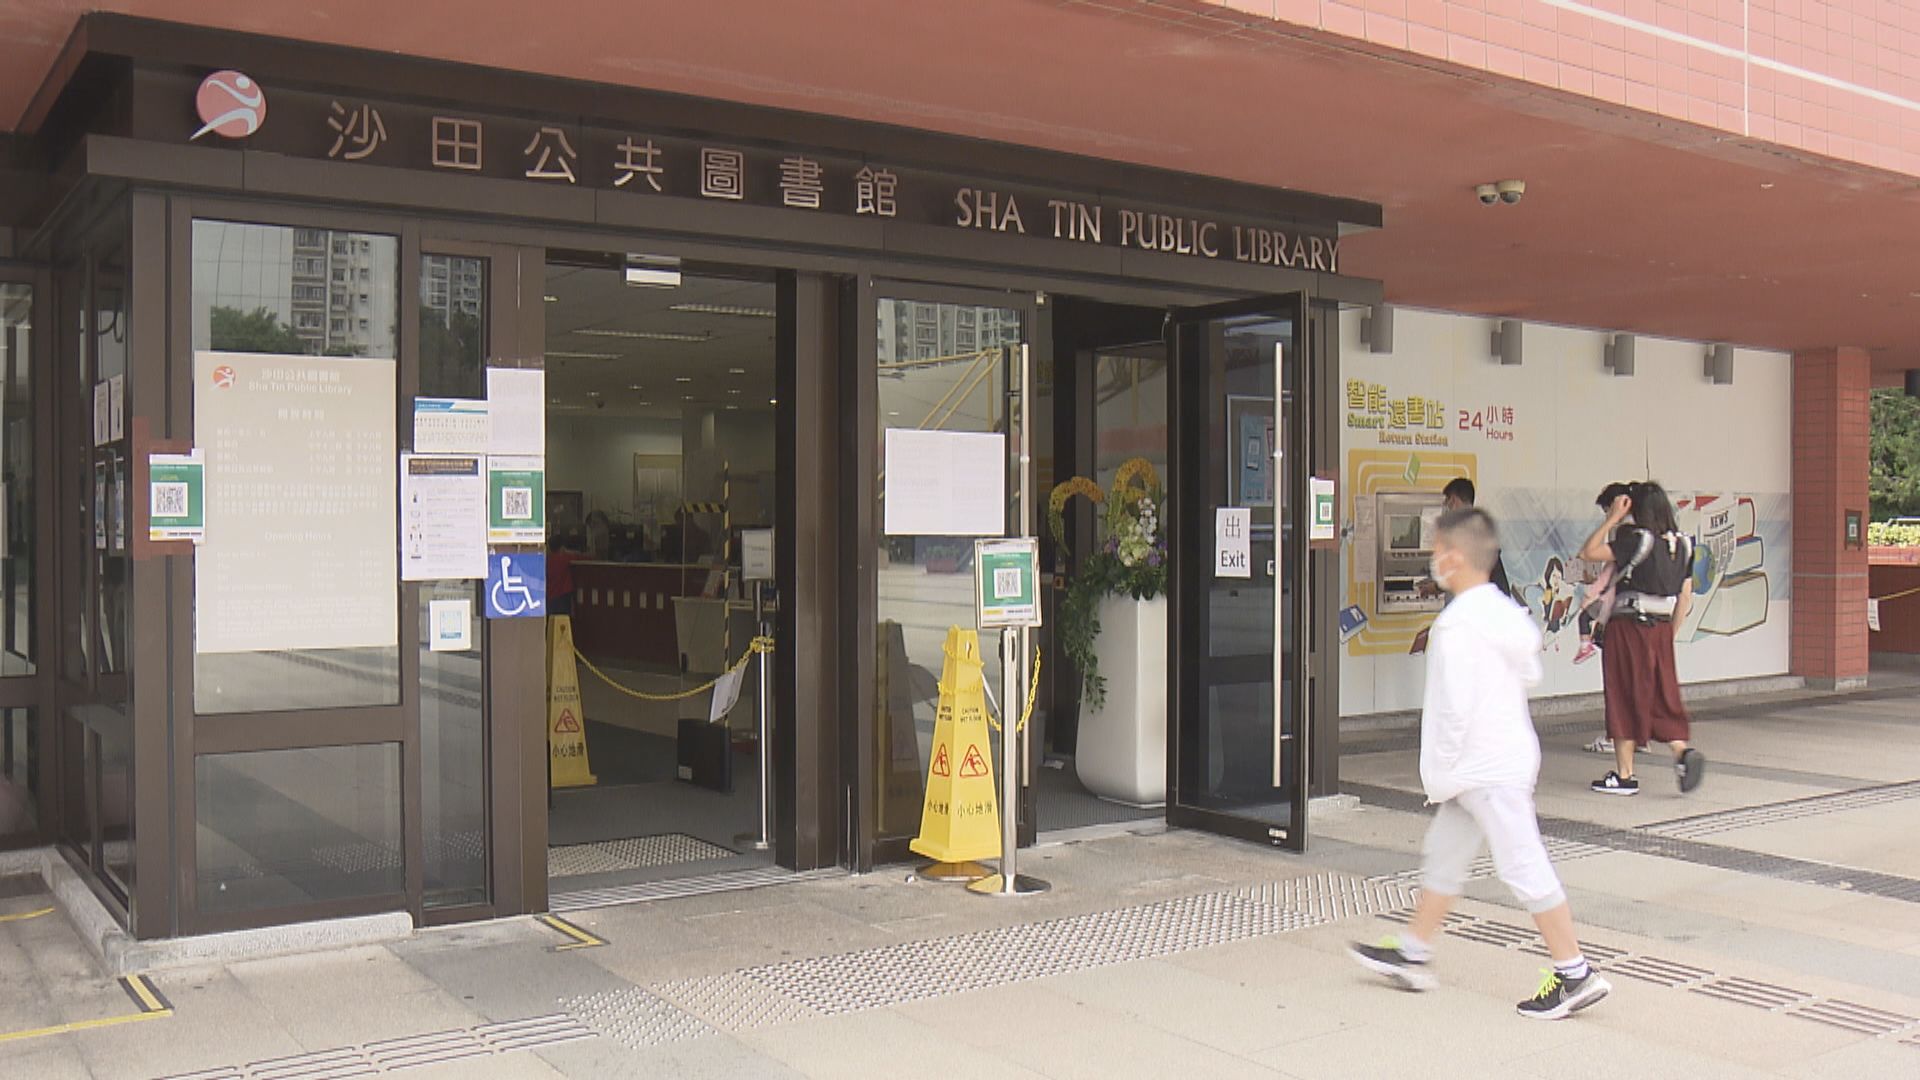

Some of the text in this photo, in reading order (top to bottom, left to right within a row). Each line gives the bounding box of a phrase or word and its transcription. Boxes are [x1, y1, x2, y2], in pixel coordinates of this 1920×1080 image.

[328, 99, 897, 217] 沙田公共圖書館
[955, 187, 1340, 273] SHA TIN PUBLIC LIBRARY
[270, 382, 286, 392] Tin
[287, 382, 317, 393] Public
[319, 382, 352, 395] Library
[1346, 378, 1445, 429] 智能還書站
[1347, 413, 1385, 429] Smart
[1458, 410, 1483, 432] 24
[1486, 405, 1514, 426] 小時
[1415, 432, 1449, 447] Station
[1486, 427, 1514, 441] Hours
[1225, 514, 1240, 539] 出
[1710, 511, 1728, 528] NEWS
[1221, 550, 1246, 568] Exit
